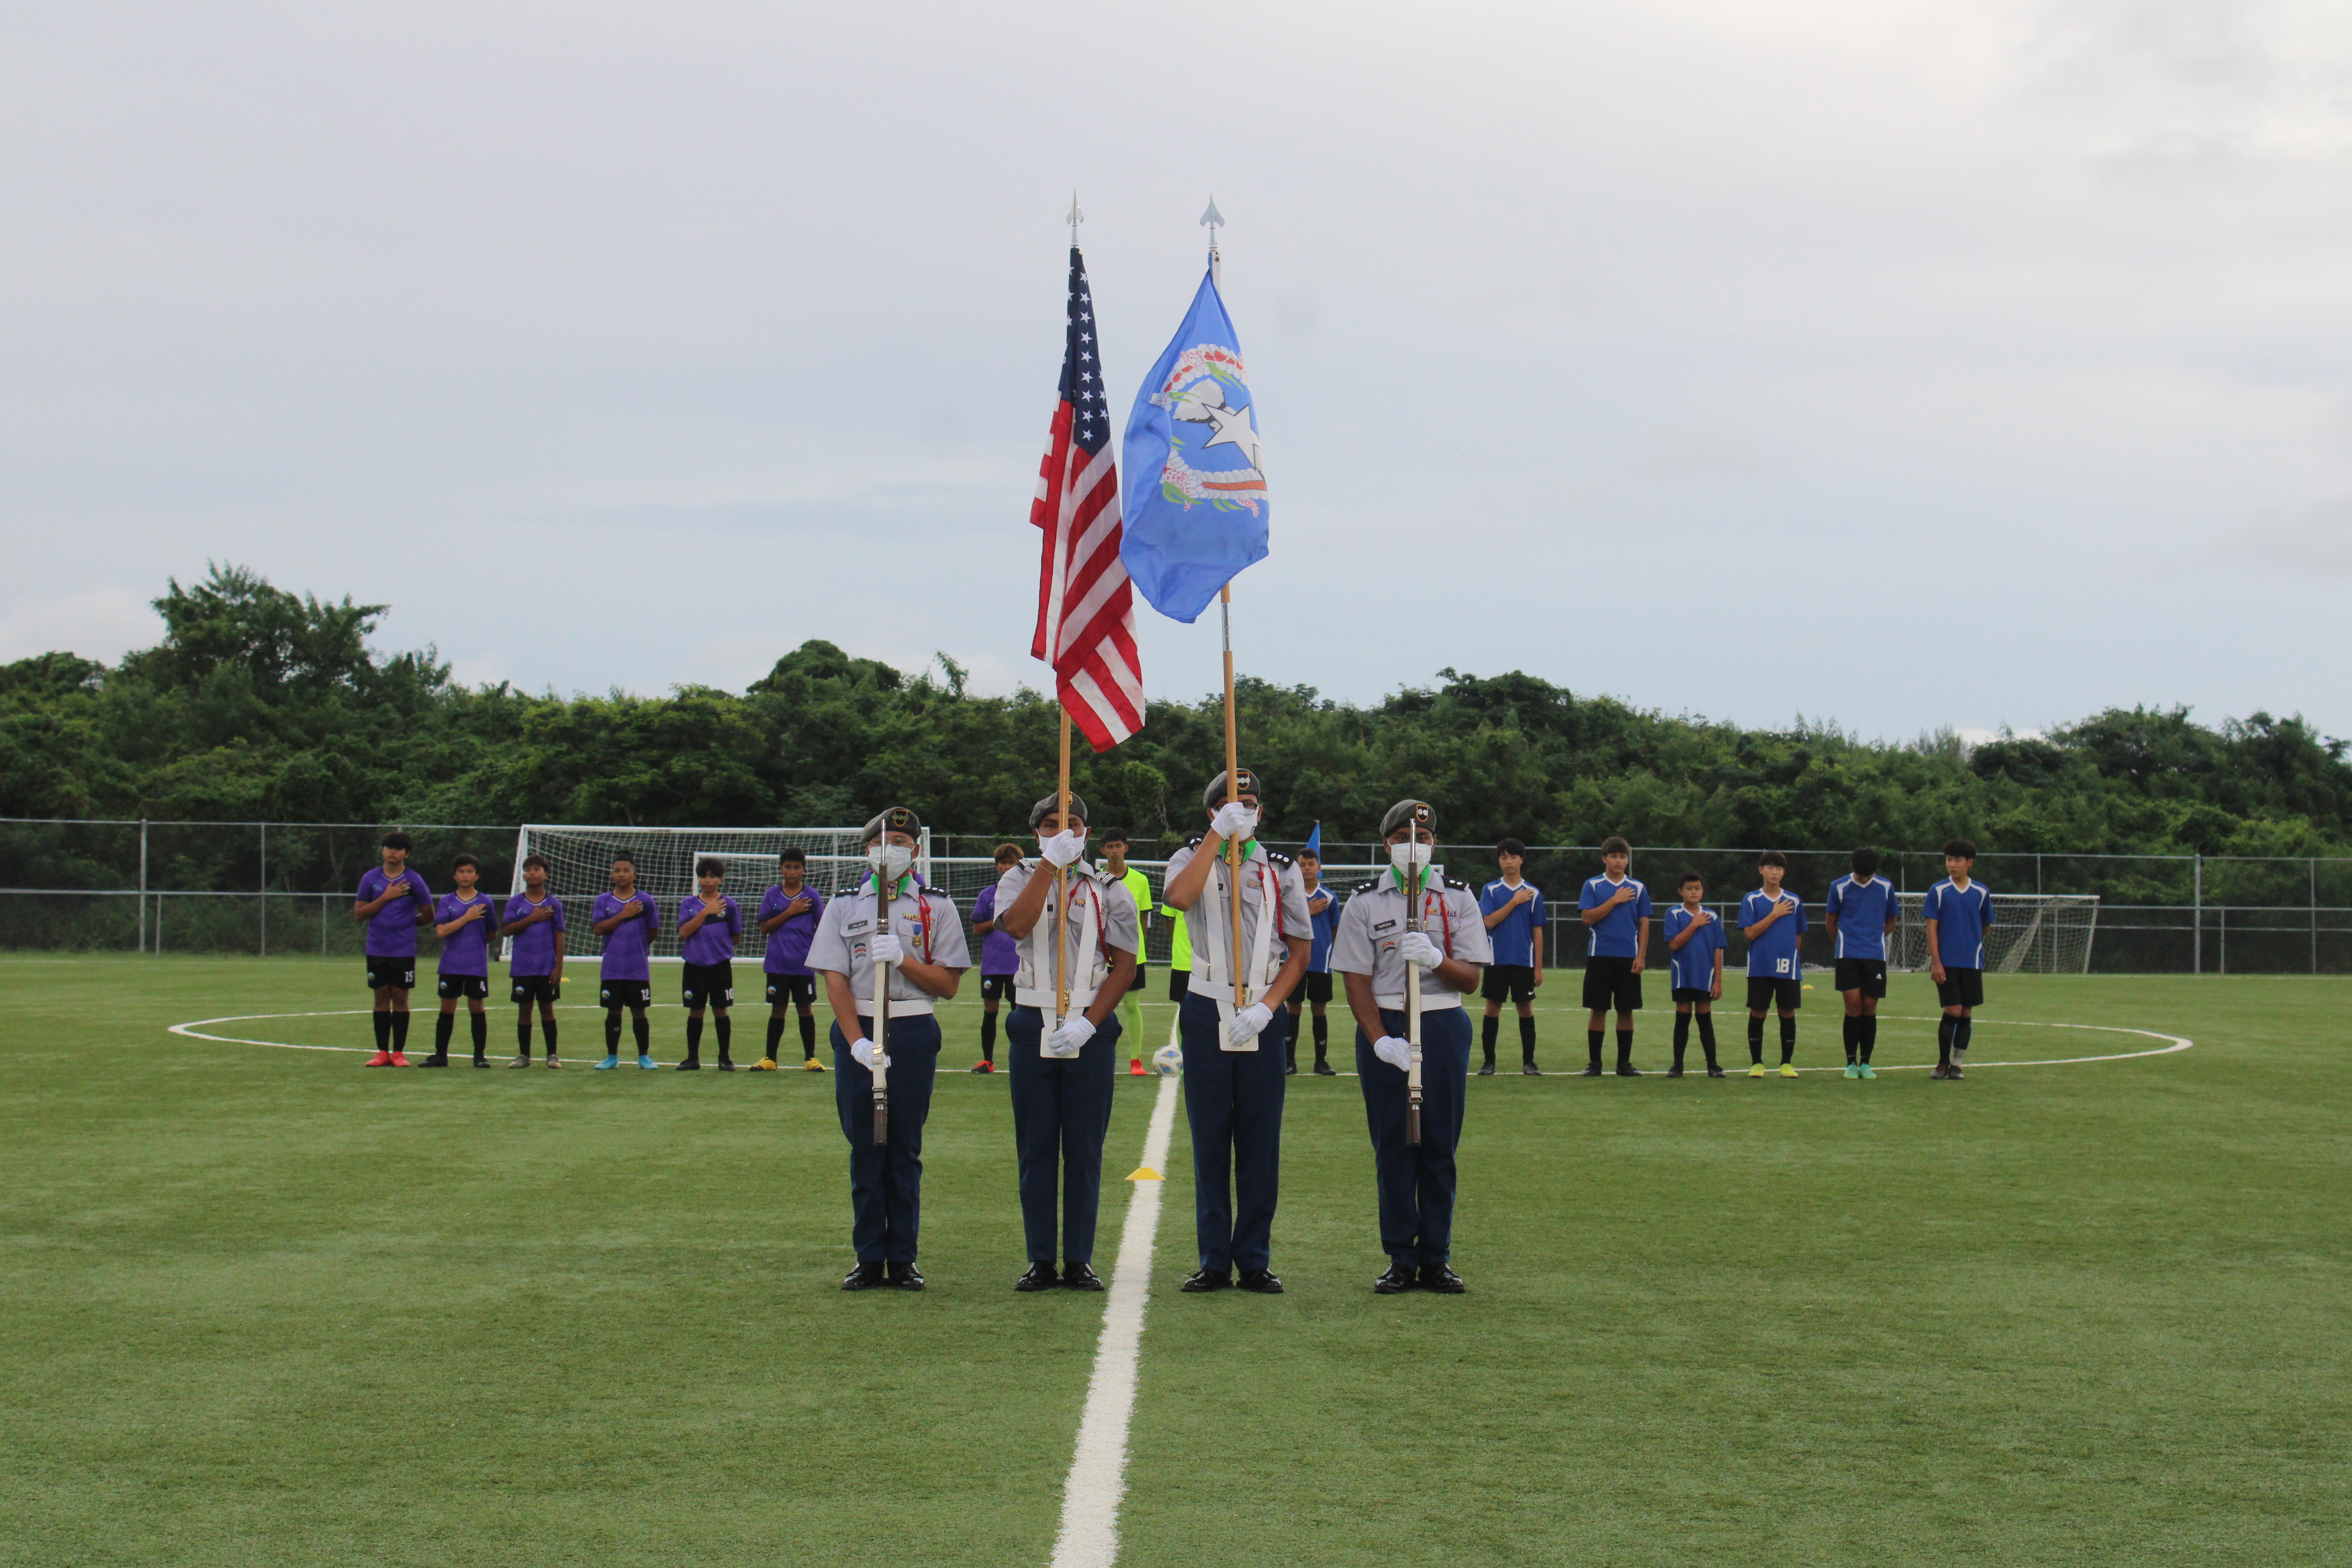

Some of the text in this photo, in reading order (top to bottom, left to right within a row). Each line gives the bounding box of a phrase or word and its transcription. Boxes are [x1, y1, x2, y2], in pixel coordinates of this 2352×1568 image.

[1776, 958, 1790, 974] 18
[404, 970, 414, 983] 15
[640, 988, 651, 1001] 12
[724, 988, 734, 1001] 10
